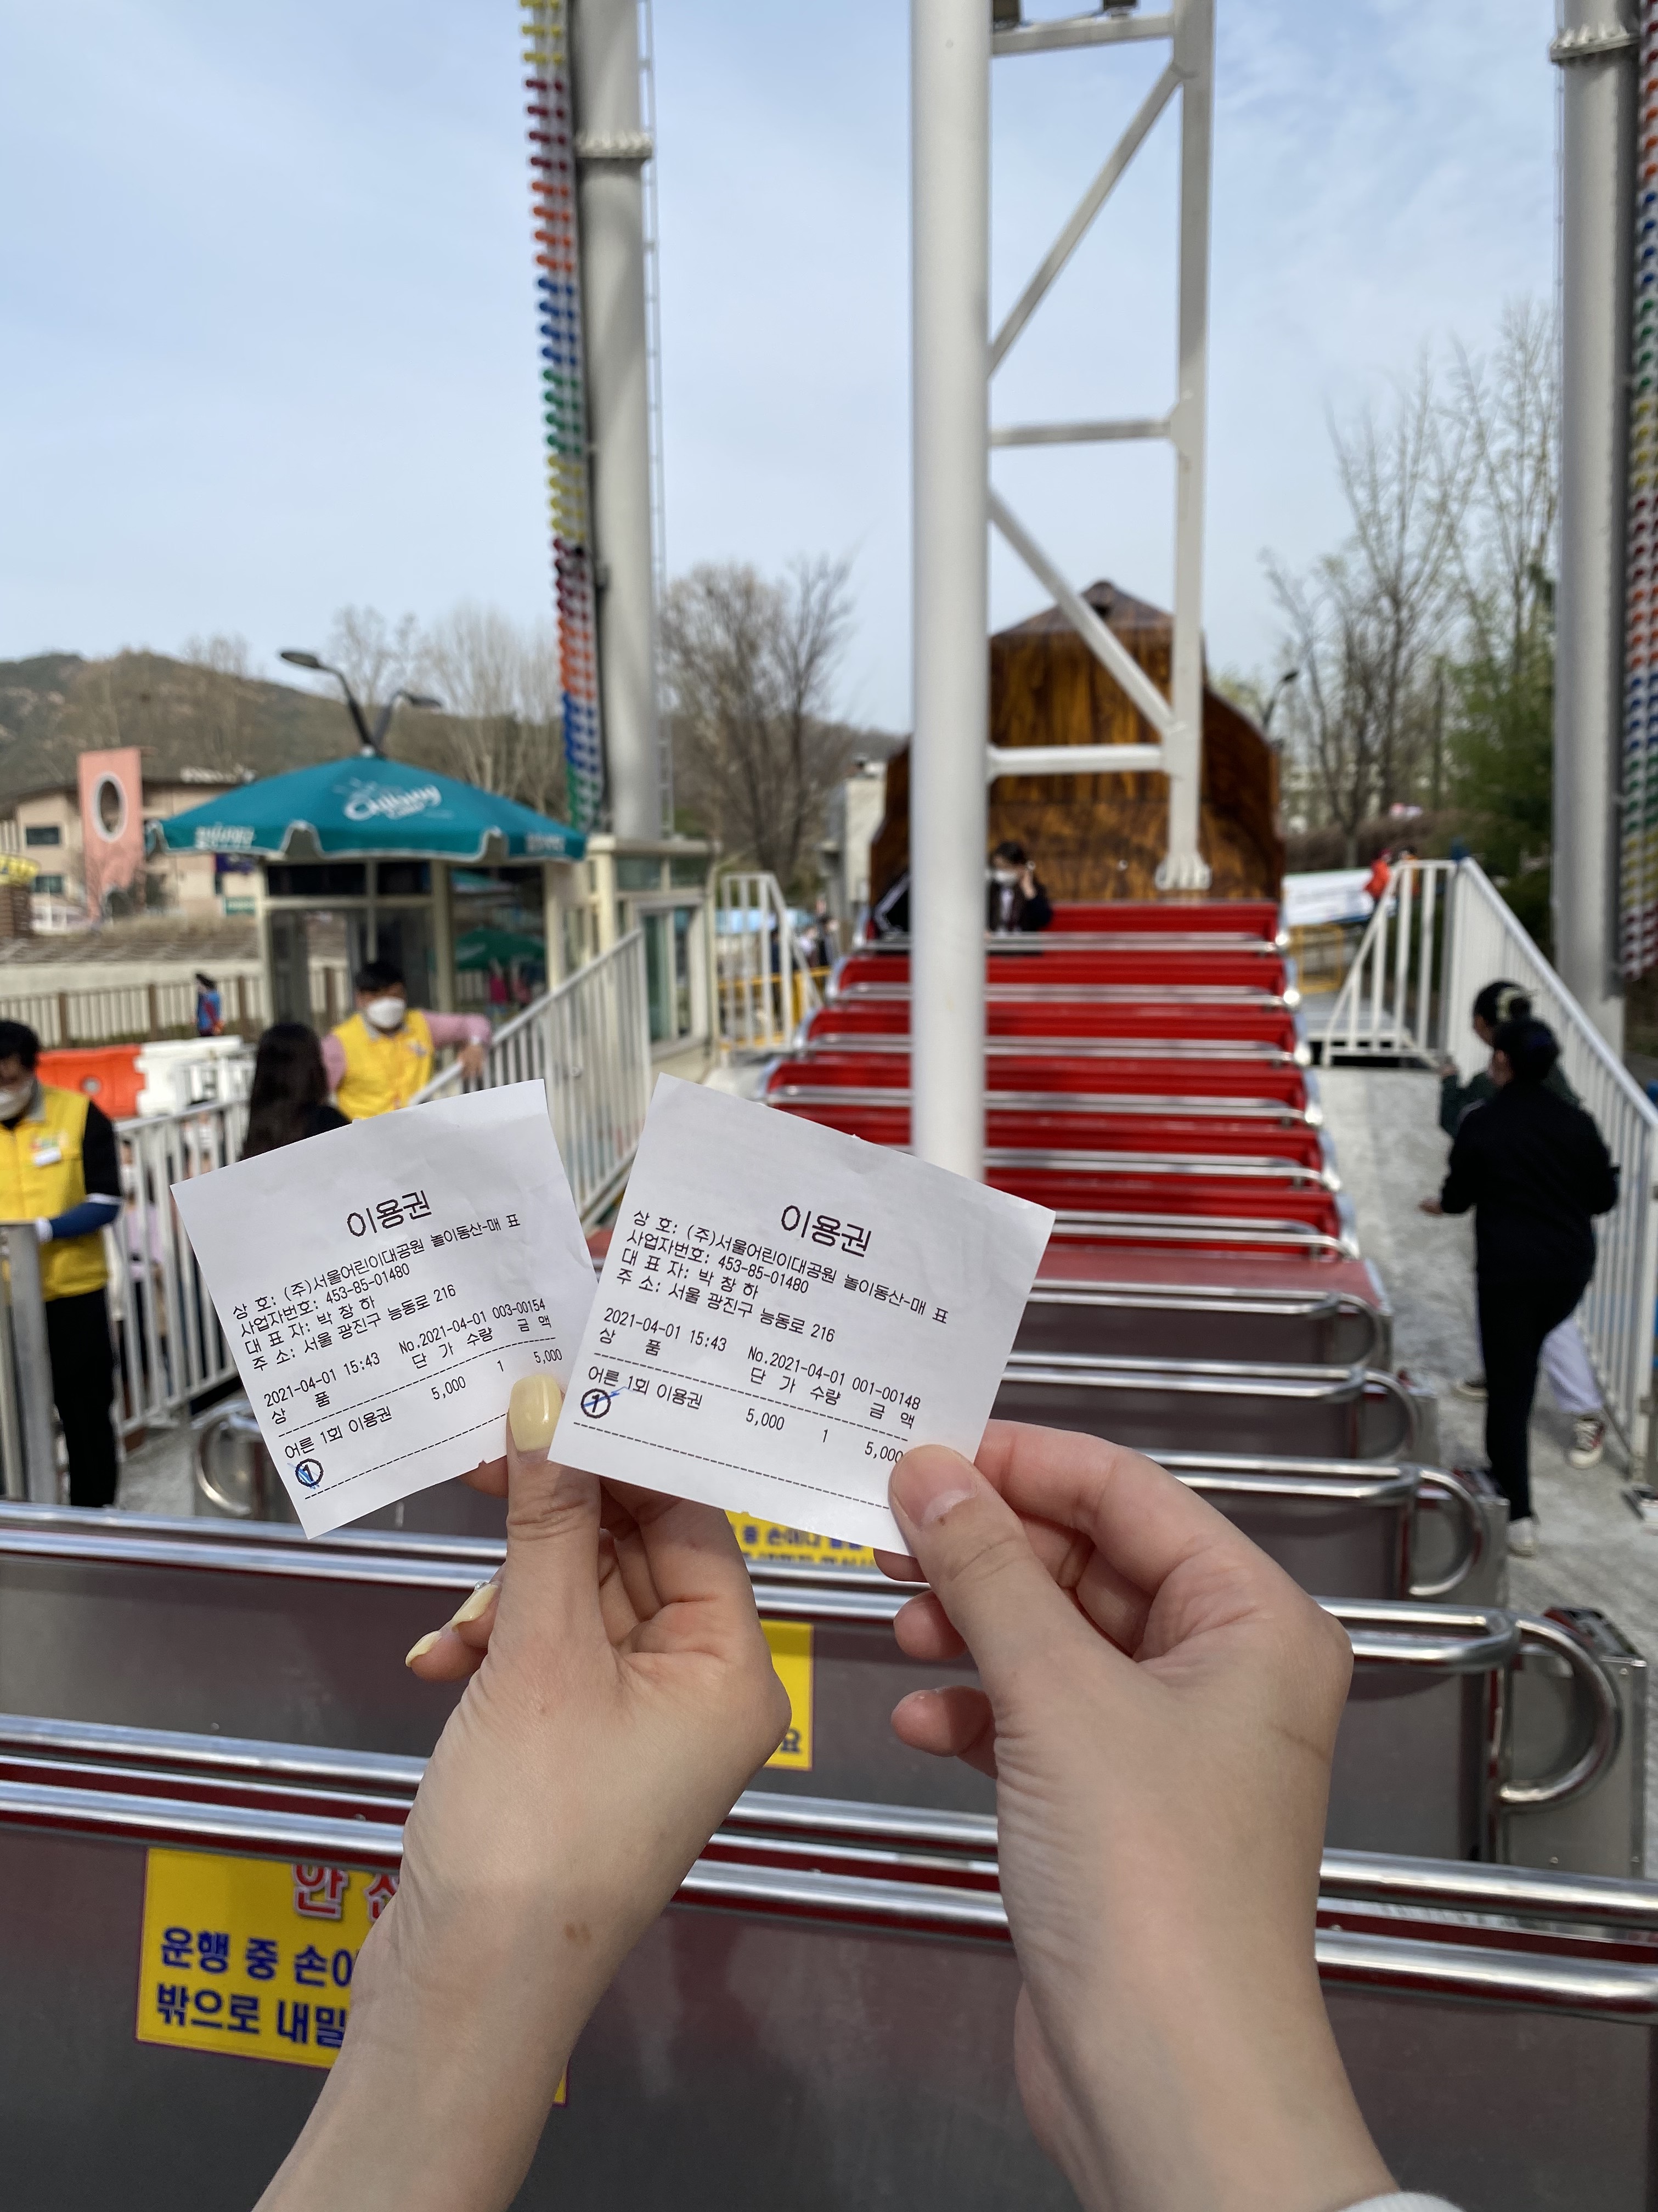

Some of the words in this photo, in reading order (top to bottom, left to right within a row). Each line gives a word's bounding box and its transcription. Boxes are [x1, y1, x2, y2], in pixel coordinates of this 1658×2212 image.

[346, 1189, 432, 1237] 이용권
[781, 1205, 872, 1258] 이용권
[627, 1229, 710, 1265] 사업자번호:
[718, 1255, 809, 1294] 453-85-01480
[241, 1300, 319, 1338] 사업자번호:
[326, 1262, 410, 1304] 453-85-01480
[304, 1331, 333, 1353] 서울
[337, 1312, 381, 1340] 광진구
[387, 1294, 431, 1321] 능동로
[433, 1284, 456, 1302] 216
[668, 1282, 701, 1305] 서울
[707, 1292, 753, 1318] 광진구
[760, 1307, 805, 1335] 능동로
[810, 1323, 836, 1342] 216
[263, 1368, 337, 1407] 2021-04-01
[343, 1352, 380, 1376] 15:43
[492, 1298, 546, 1319] 003-00154
[466, 1327, 493, 1346] 수량
[604, 1307, 681, 1340] 2021-04-01
[690, 1329, 727, 1352] 15:43
[851, 1376, 921, 1410] 001-00148
[284, 1436, 315, 1459] 어른
[320, 1425, 343, 1444] 1회
[348, 1406, 392, 1432] 이용권
[431, 1376, 466, 1400] 5,000
[533, 1348, 562, 1364] 5,000
[588, 1365, 620, 1387] 어른
[627, 1375, 650, 1396] 1회
[656, 1384, 703, 1410] 이용권
[746, 1407, 785, 1431] 5,000
[810, 1385, 842, 1406] 수량
[161, 1926, 229, 1974] 운행
[245, 1937, 279, 1981] 중
[156, 1983, 261, 2035] 밖으로
